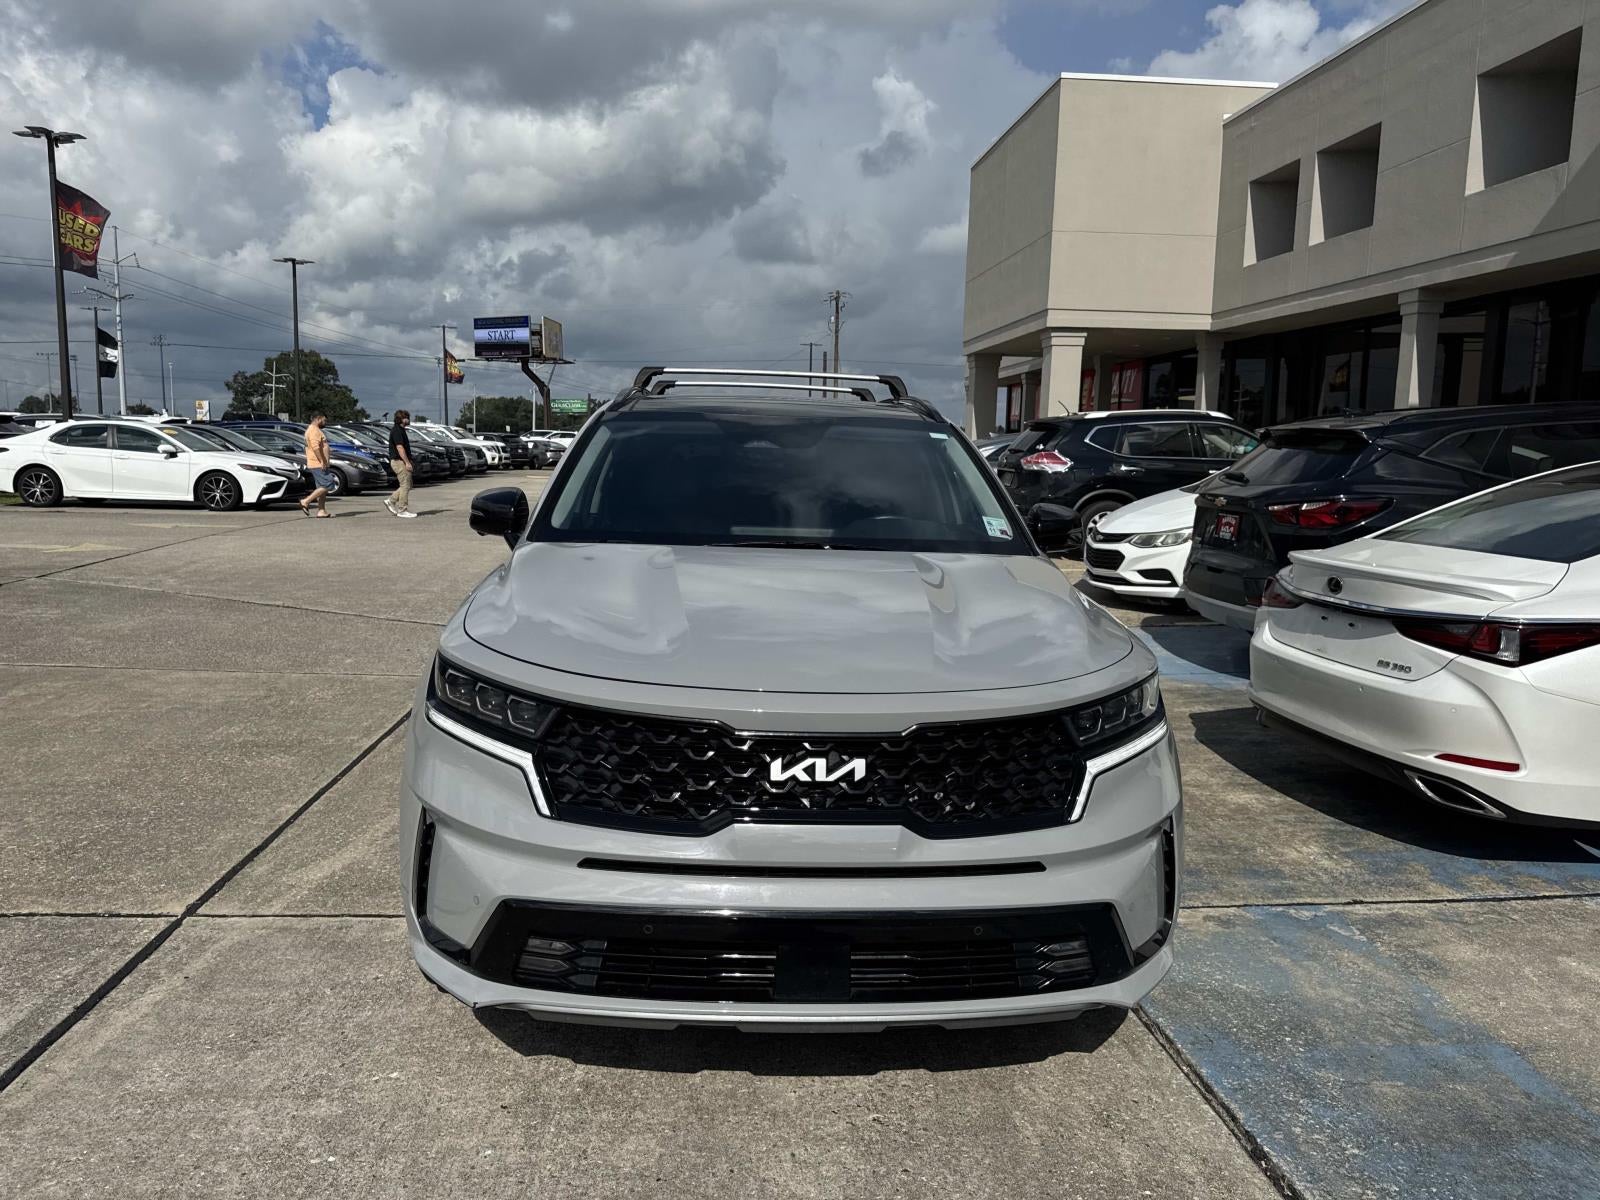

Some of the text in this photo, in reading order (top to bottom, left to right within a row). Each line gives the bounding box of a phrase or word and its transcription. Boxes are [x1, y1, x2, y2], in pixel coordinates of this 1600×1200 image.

[58, 208, 100, 237] USED
[59, 227, 96, 252] CARS
[487, 329, 515, 341] START
[770, 757, 866, 782] KIA
